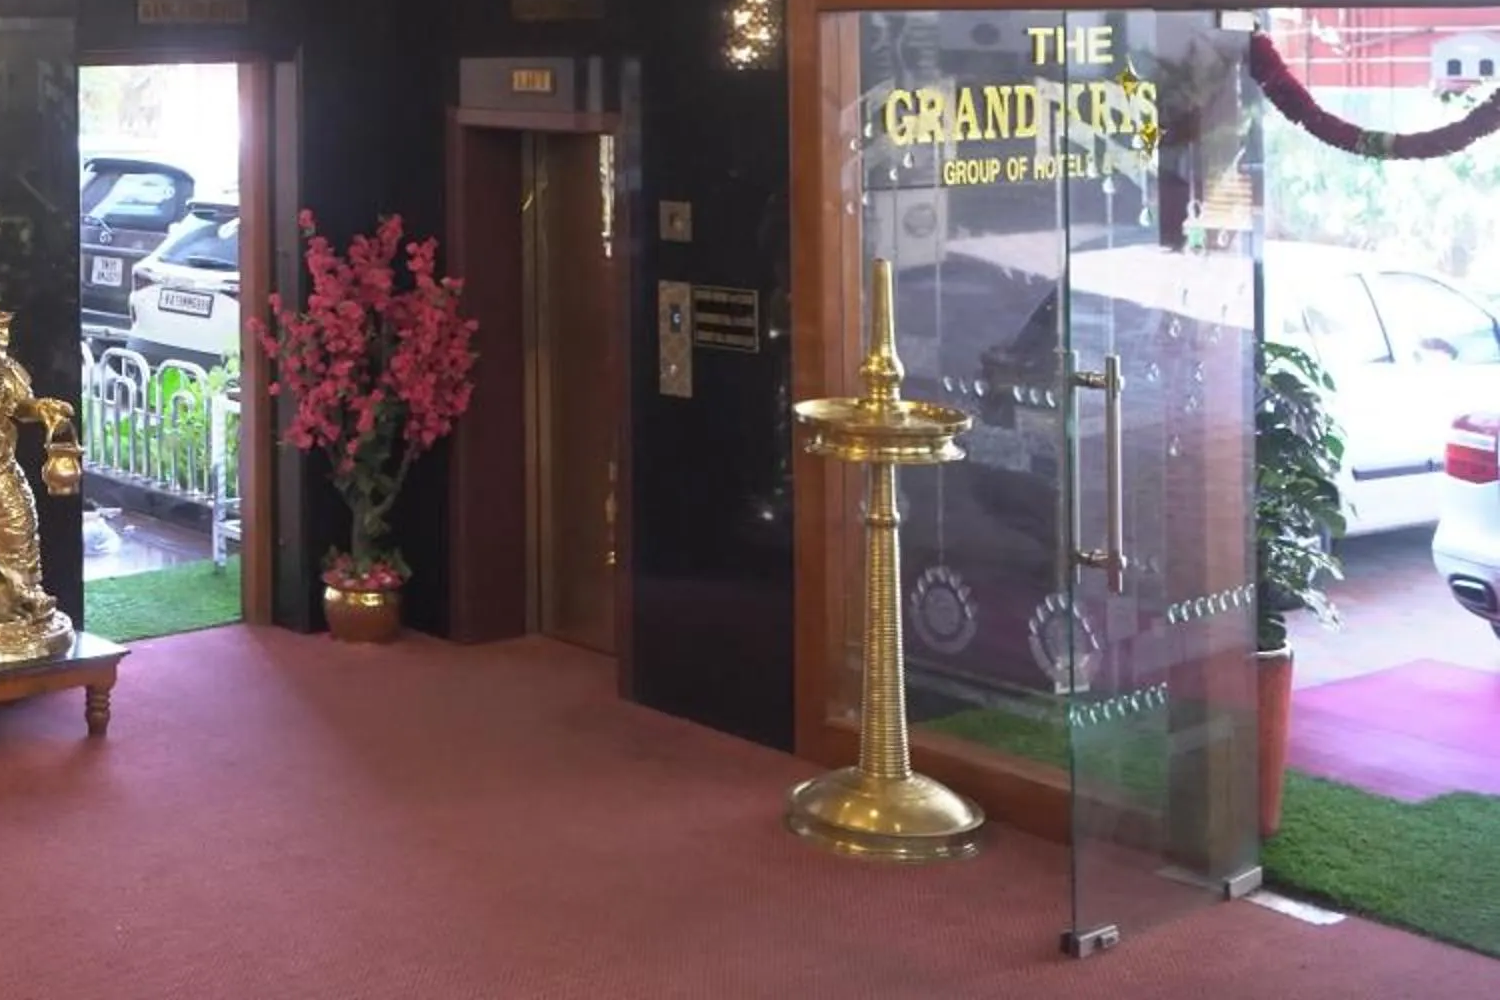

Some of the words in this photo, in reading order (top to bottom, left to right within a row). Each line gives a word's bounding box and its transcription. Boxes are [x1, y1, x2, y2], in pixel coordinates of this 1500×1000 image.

[1027, 25, 1114, 65] THE
[886, 83, 1040, 146] GRAND
[943, 157, 1000, 185] GROUP
[1006, 156, 1028, 181] OF
